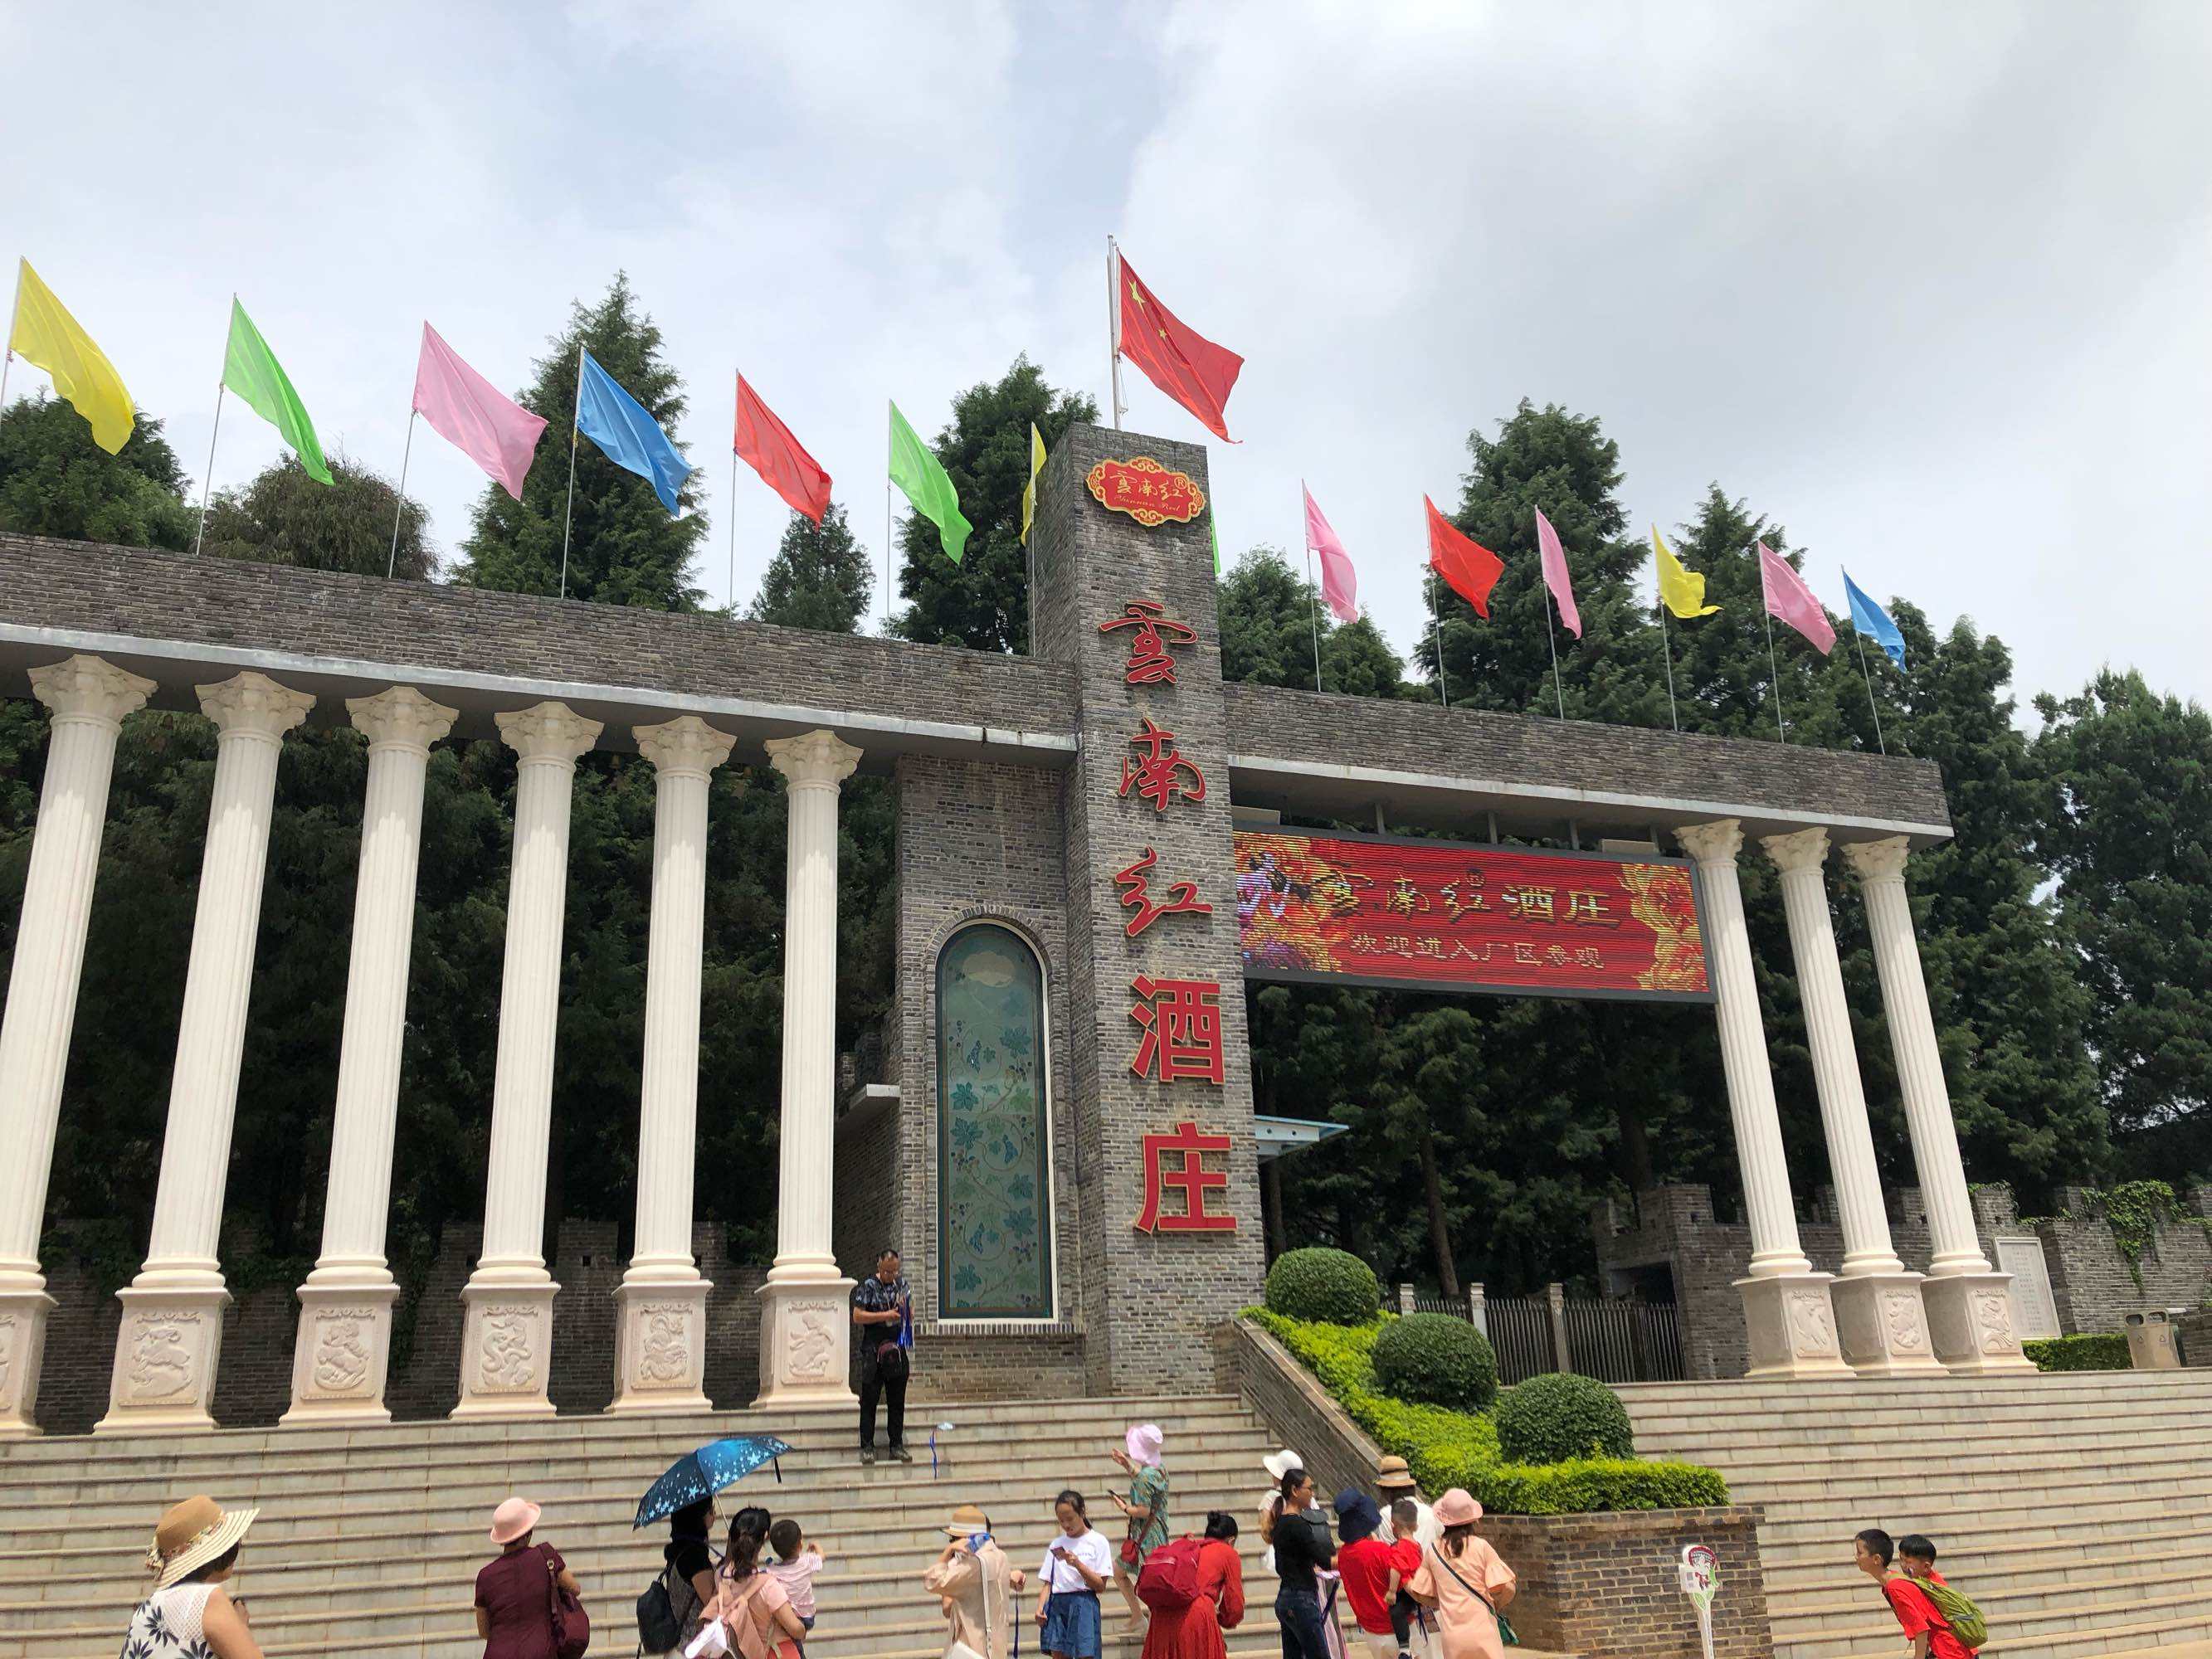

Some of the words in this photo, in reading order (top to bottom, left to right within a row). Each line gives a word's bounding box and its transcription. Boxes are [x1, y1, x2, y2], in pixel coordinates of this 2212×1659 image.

[1350, 932, 1605, 969] 欢迎进入厂区参观
